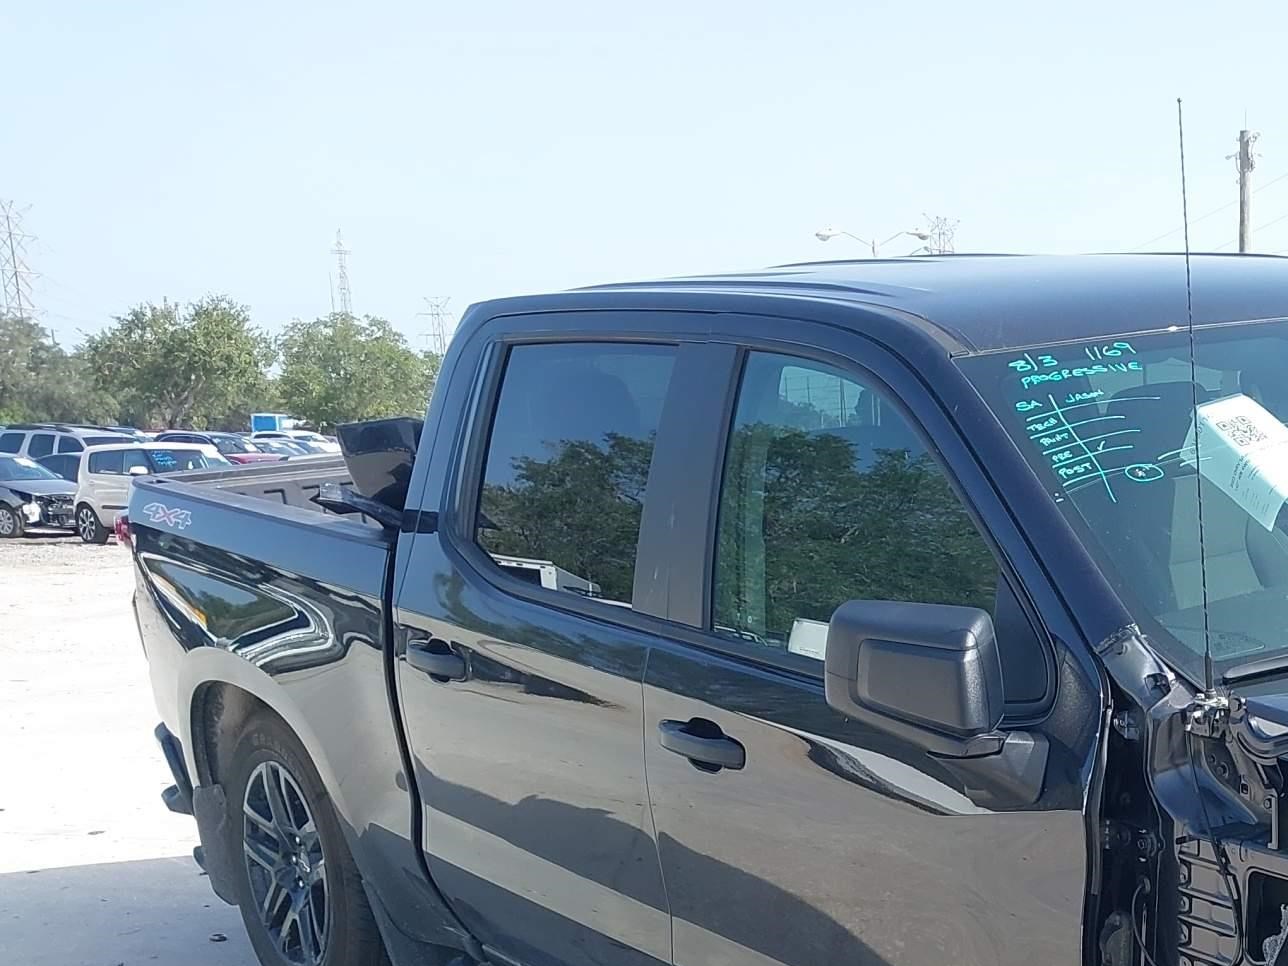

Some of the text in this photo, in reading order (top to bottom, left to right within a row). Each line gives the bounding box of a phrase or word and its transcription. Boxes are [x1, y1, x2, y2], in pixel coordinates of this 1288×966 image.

[1007, 341, 1137, 372] 8/3 1169
[1020, 361, 1144, 390] PROGRESSIVE
[1015, 399, 1043, 412] SA
[1025, 417, 1059, 433] TECH
[1057, 461, 1093, 480] POST
